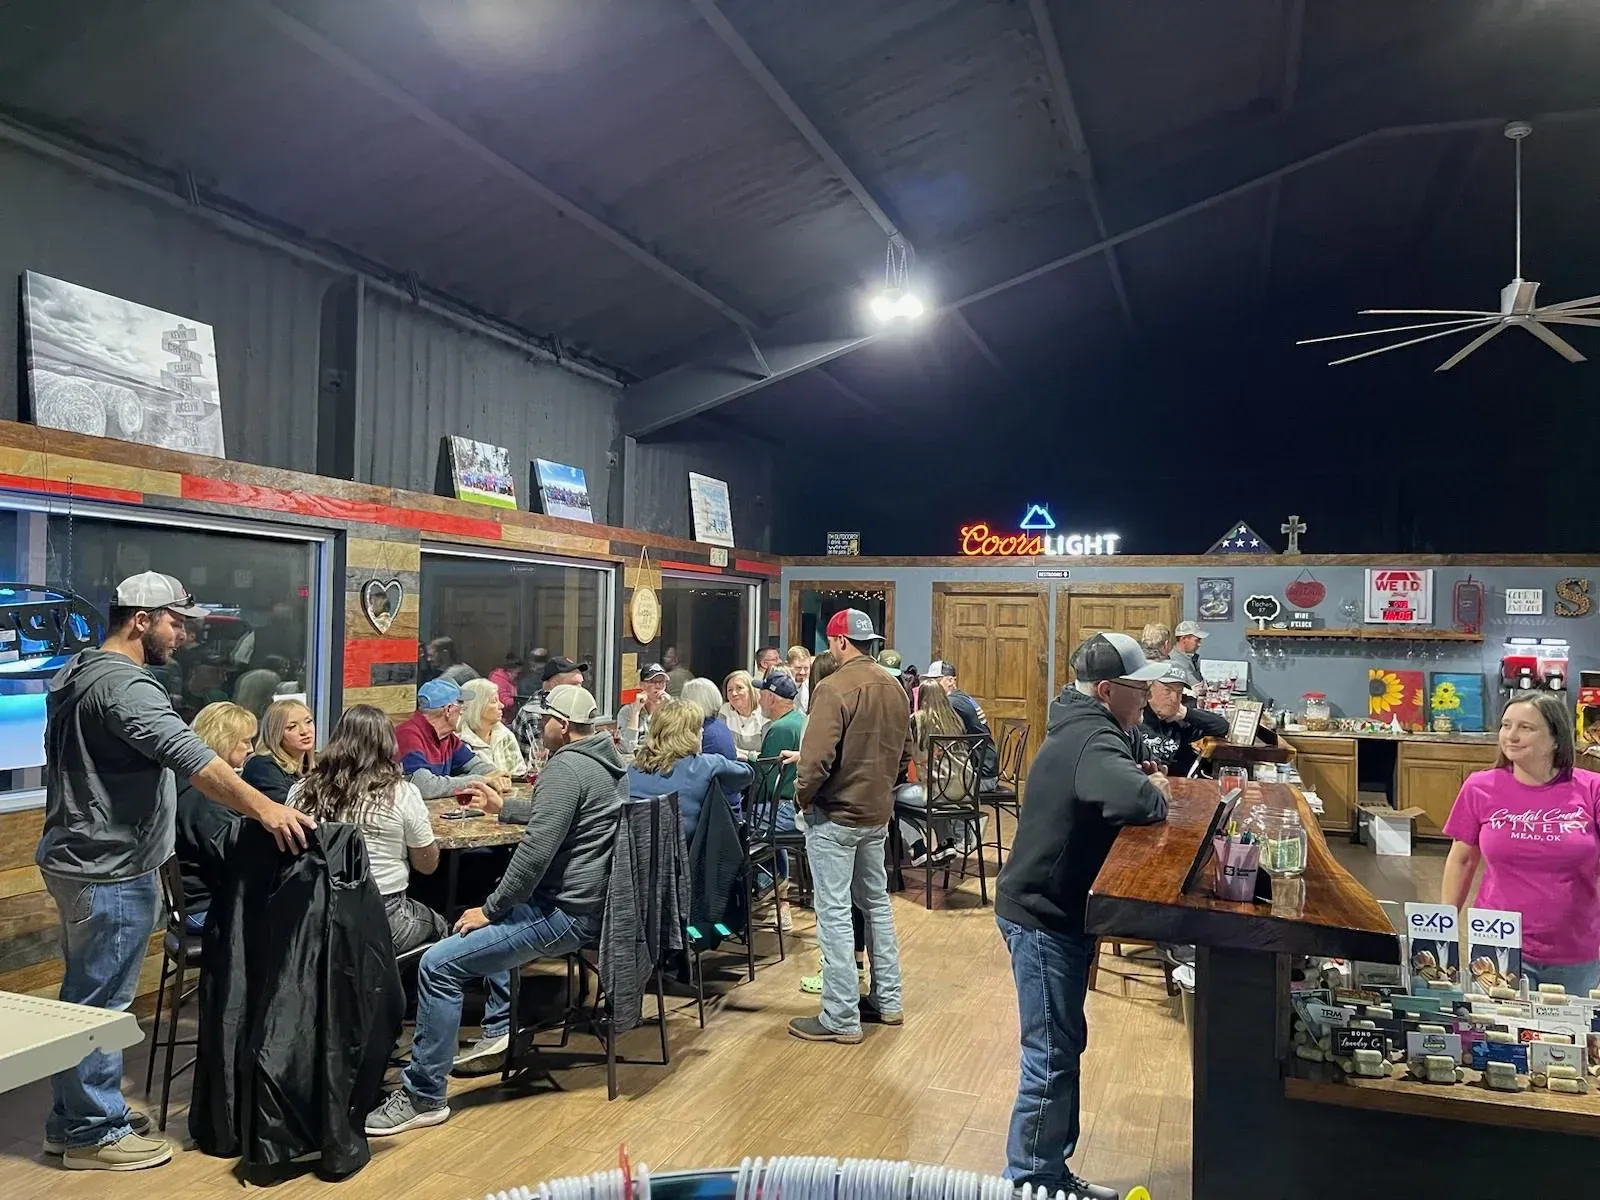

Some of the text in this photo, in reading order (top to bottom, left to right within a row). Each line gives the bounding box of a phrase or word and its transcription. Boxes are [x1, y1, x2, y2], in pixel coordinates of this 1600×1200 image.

[961, 524, 1120, 555] Coors LIGHT
[1375, 580, 1398, 591] WE
[1489, 806, 1584, 822] Crystal Creek
[1490, 819, 1588, 833] WINERY
[1546, 834, 1561, 842] OK
